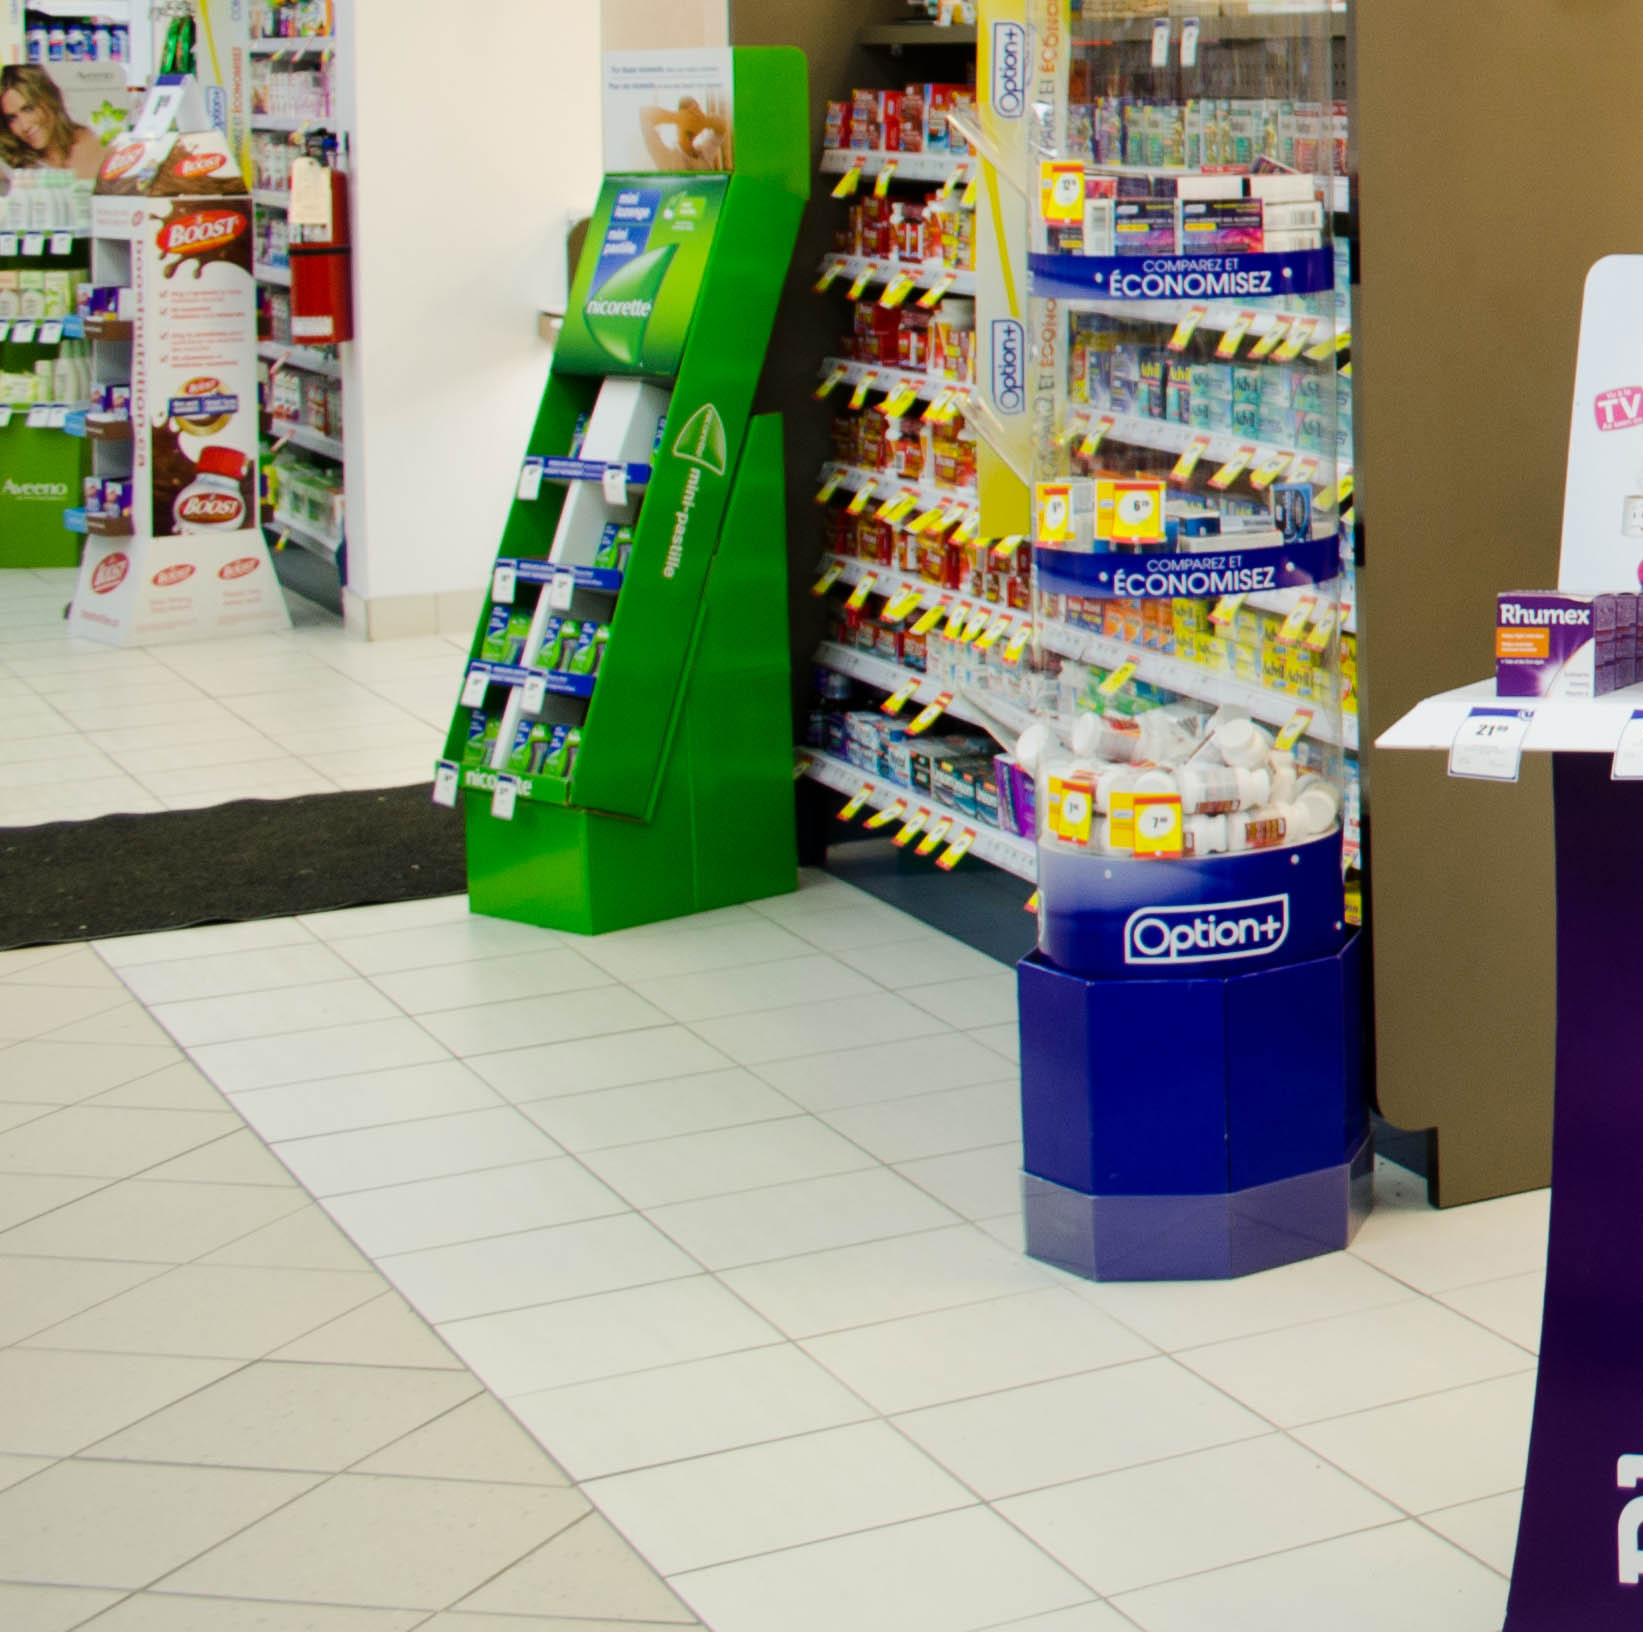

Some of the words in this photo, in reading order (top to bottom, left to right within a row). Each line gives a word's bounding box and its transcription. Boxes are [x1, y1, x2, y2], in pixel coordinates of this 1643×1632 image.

[998, 25, 1023, 114] Option+
[167, 215, 239, 249] BOOST
[1143, 258, 1222, 275] COMPAREZ
[1225, 258, 1239, 272] ET
[1109, 268, 1272, 296] ÉCONOMISEZ
[586, 298, 652, 318] nicorette
[998, 324, 1023, 411] Option+
[1597, 393, 1642, 424] TV
[1, 479, 69, 498] Aveeno
[182, 497, 237, 516] BOOST
[1146, 556, 1225, 573] COMPAREZ
[1229, 555, 1242, 569] ET
[1113, 566, 1275, 597] ÉCONOMISEZ
[1499, 603, 1591, 625] Rhumex
[1132, 912, 1282, 960] Option+
